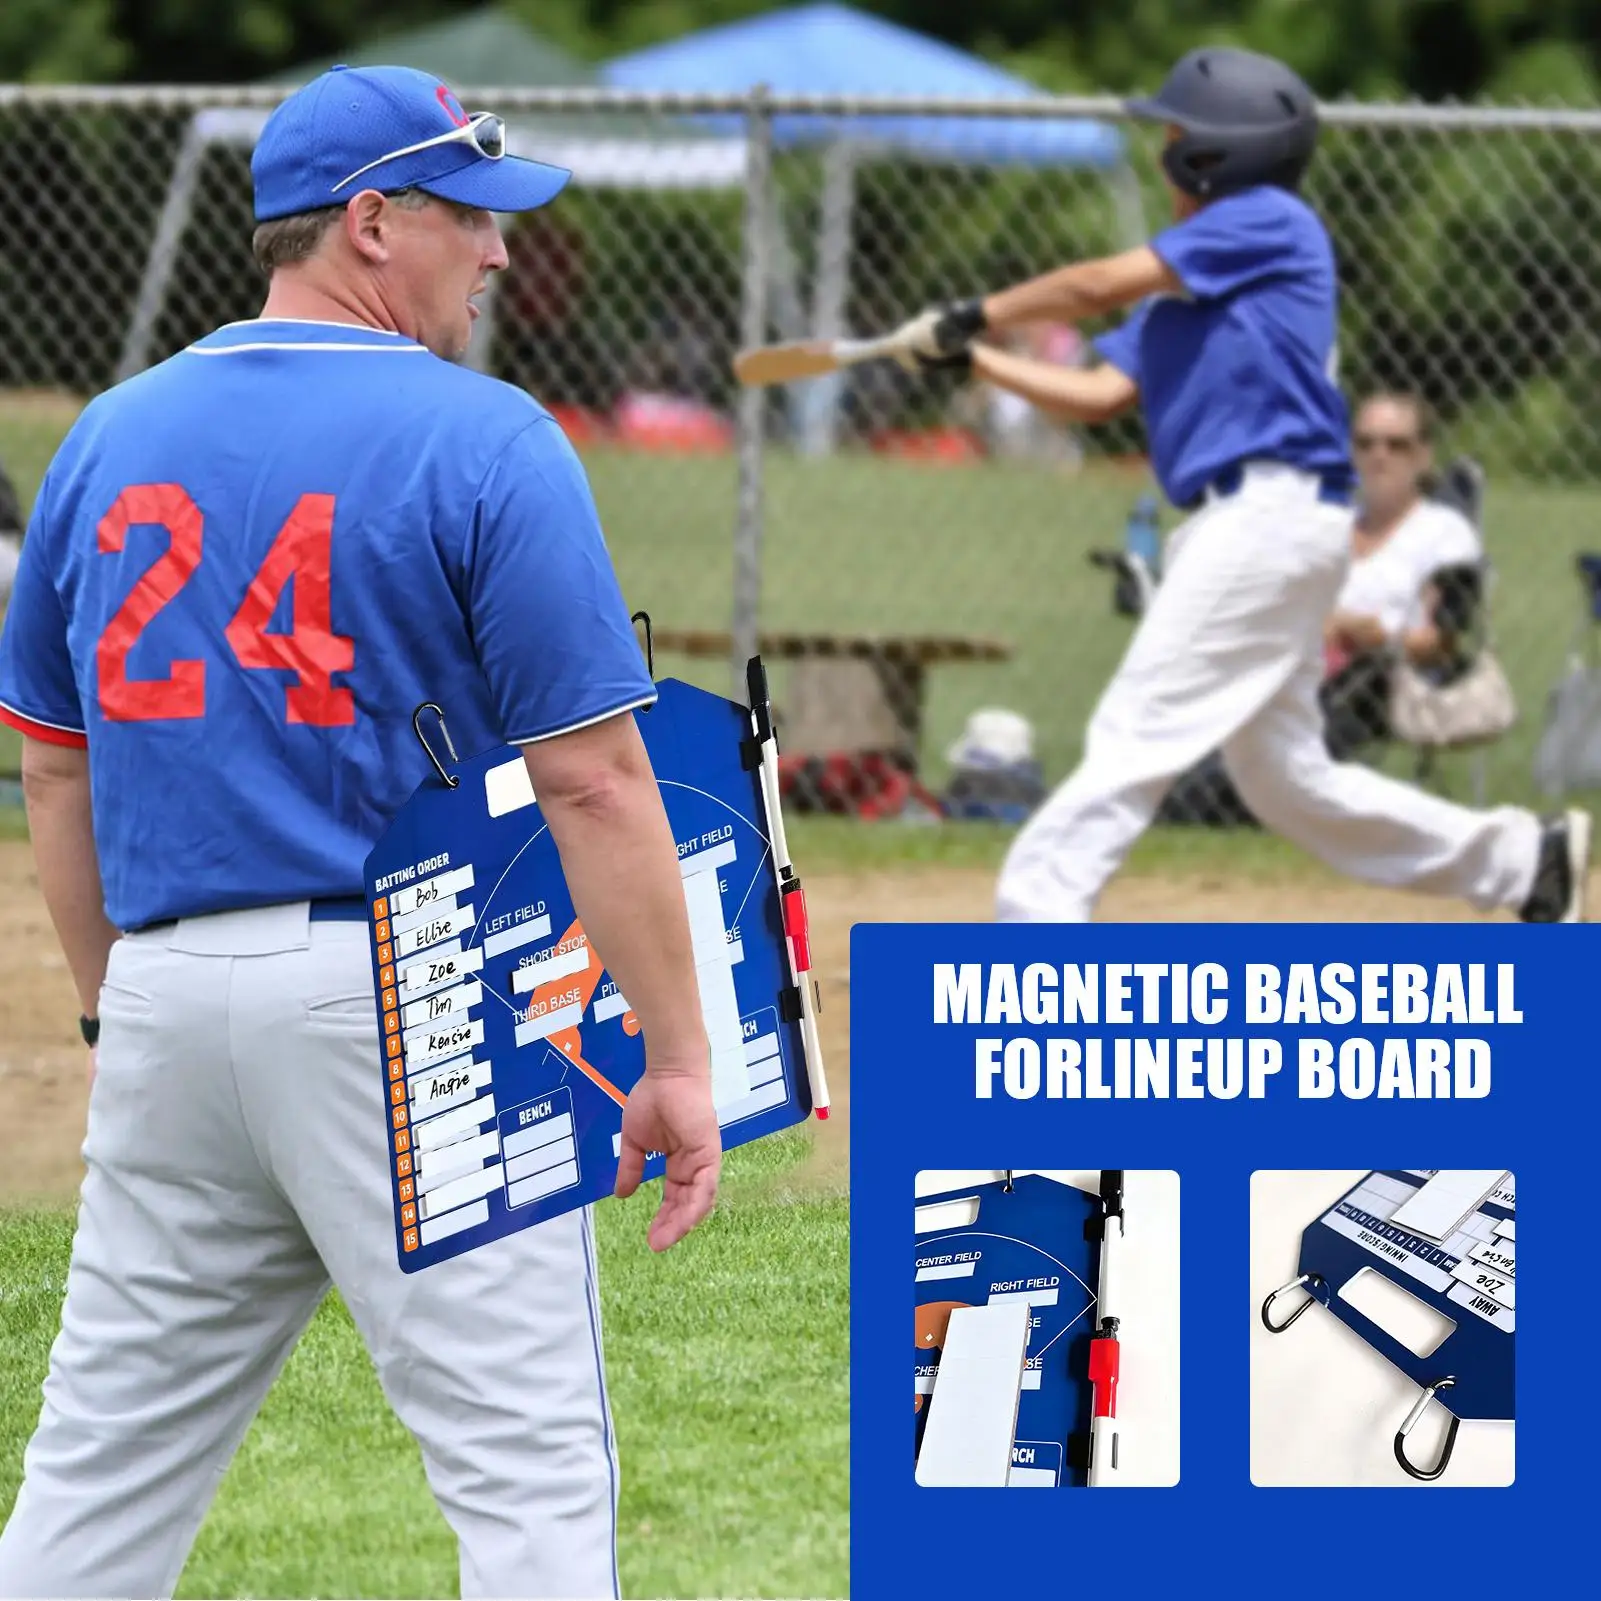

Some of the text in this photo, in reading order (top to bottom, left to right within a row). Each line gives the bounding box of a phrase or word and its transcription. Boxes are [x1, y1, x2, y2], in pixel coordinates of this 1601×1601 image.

[96, 482, 355, 727] 24
[677, 824, 733, 856] GHT FIELD
[375, 852, 450, 892] BATTING ORDER
[416, 881, 438, 908] Bob
[377, 904, 384, 914] 1
[485, 900, 546, 934] LEFT FIELD
[380, 926, 386, 937] 2
[725, 926, 741, 943] SE
[382, 949, 388, 959] 3
[518, 934, 587, 969] SHORT STOP
[384, 972, 390, 982] 4
[428, 961, 456, 983] Zoe
[386, 994, 393, 1005] 5
[426, 996, 452, 1019] Tim
[512, 987, 581, 1025] THIRD BASE
[388, 1017, 395, 1028] 6
[391, 1040, 396, 1051] 7
[392, 1064, 399, 1075] 8
[430, 1071, 470, 1100] Angie
[395, 1088, 401, 1098] 9
[395, 1111, 406, 1122] 10
[519, 1100, 552, 1125] BENCH
[397, 1136, 407, 1146] 11
[399, 1159, 410, 1170] 12
[401, 1184, 412, 1195] 13
[403, 1208, 414, 1220] 14
[405, 1233, 416, 1245] 15
[1357, 1230, 1409, 1263] INNING/SCORE
[1420, 1246, 1429, 1254] 2
[915, 1251, 982, 1268] CENTER FIELD
[990, 1276, 1060, 1293] RIGHT FIELD
[1476, 1274, 1505, 1295] Zoe
[1469, 1296, 1500, 1316] AWAY
[1027, 1317, 1041, 1328] SE
[1025, 1358, 1043, 1369] SE
